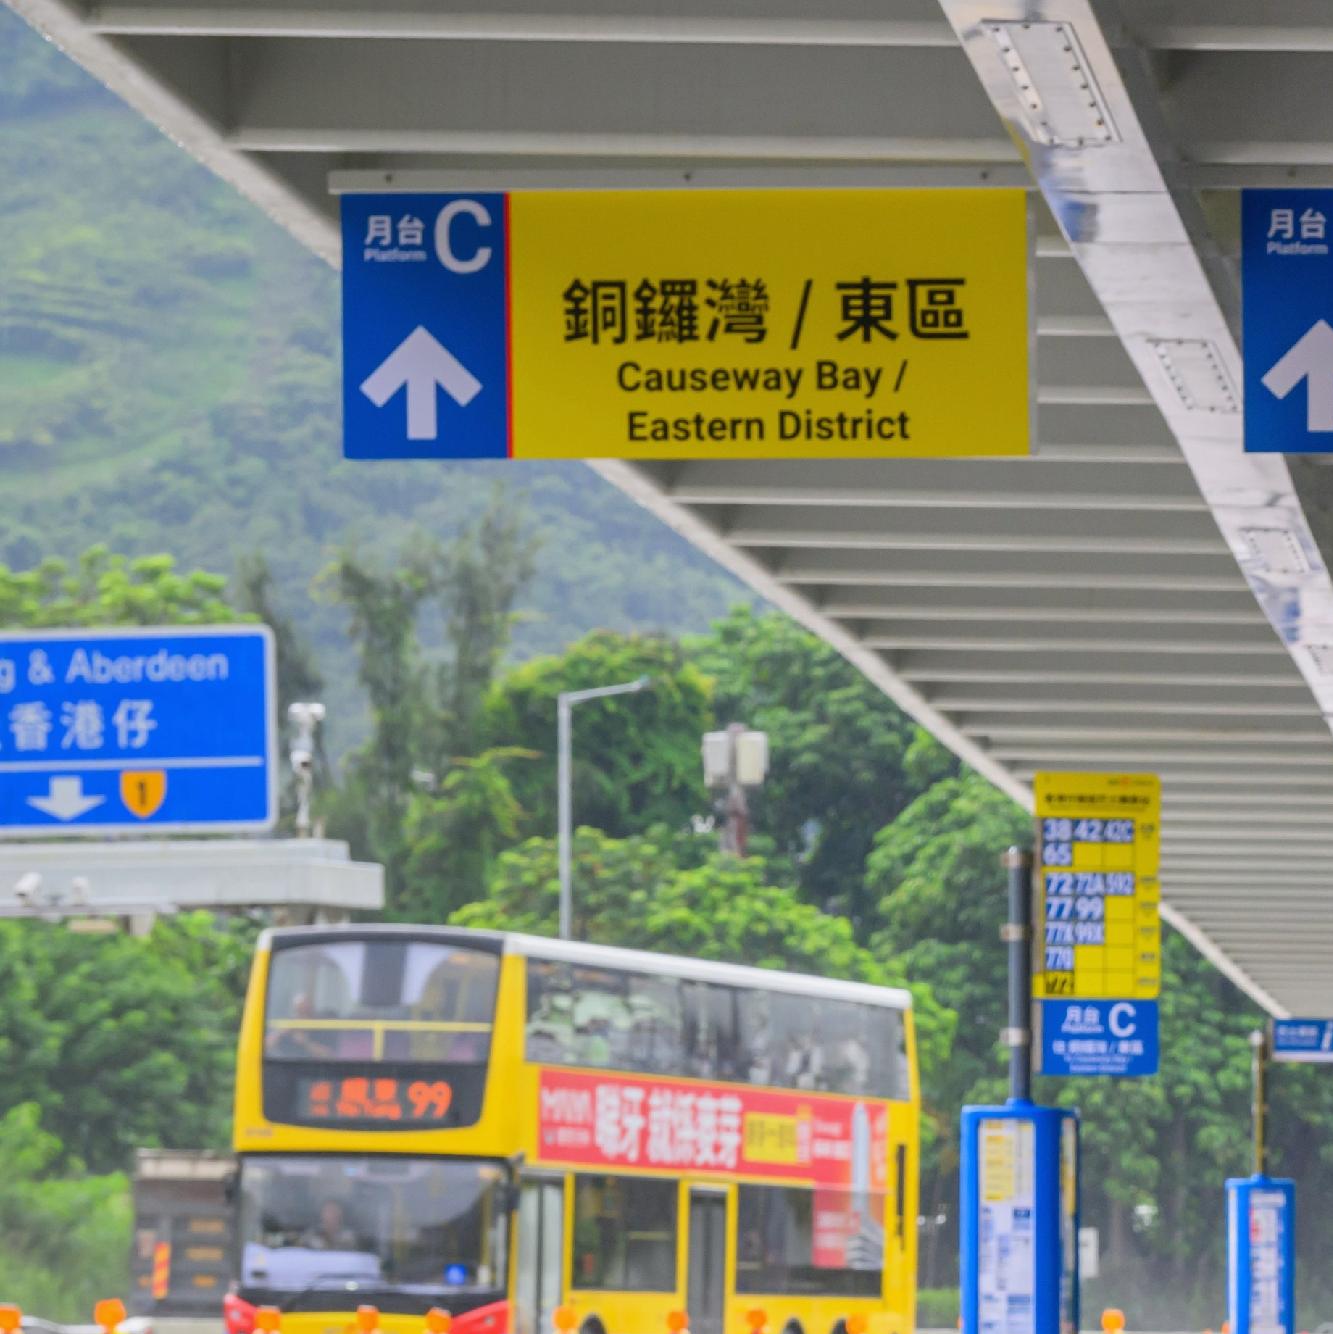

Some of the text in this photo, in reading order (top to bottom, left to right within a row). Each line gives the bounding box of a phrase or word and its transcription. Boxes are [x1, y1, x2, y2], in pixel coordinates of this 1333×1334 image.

[364, 214, 426, 246] 月台
[433, 199, 492, 274] C
[1266, 208, 1327, 240] 月台
[1266, 241, 1329, 255] Platform
[561, 277, 970, 349] 銅鑼灣 / 東區
[616, 360, 802, 399] Causeway
[815, 360, 882, 399] Bay
[627, 410, 910, 443] Eastern District
[28, 649, 54, 686] &
[65, 648, 229, 685] Aberdeen
[9, 699, 158, 751] 香港仔
[1074, 819, 1104, 842] 42
[1046, 896, 1074, 919] 77
[1109, 1003, 1136, 1037] C
[407, 1080, 453, 1119] 99
